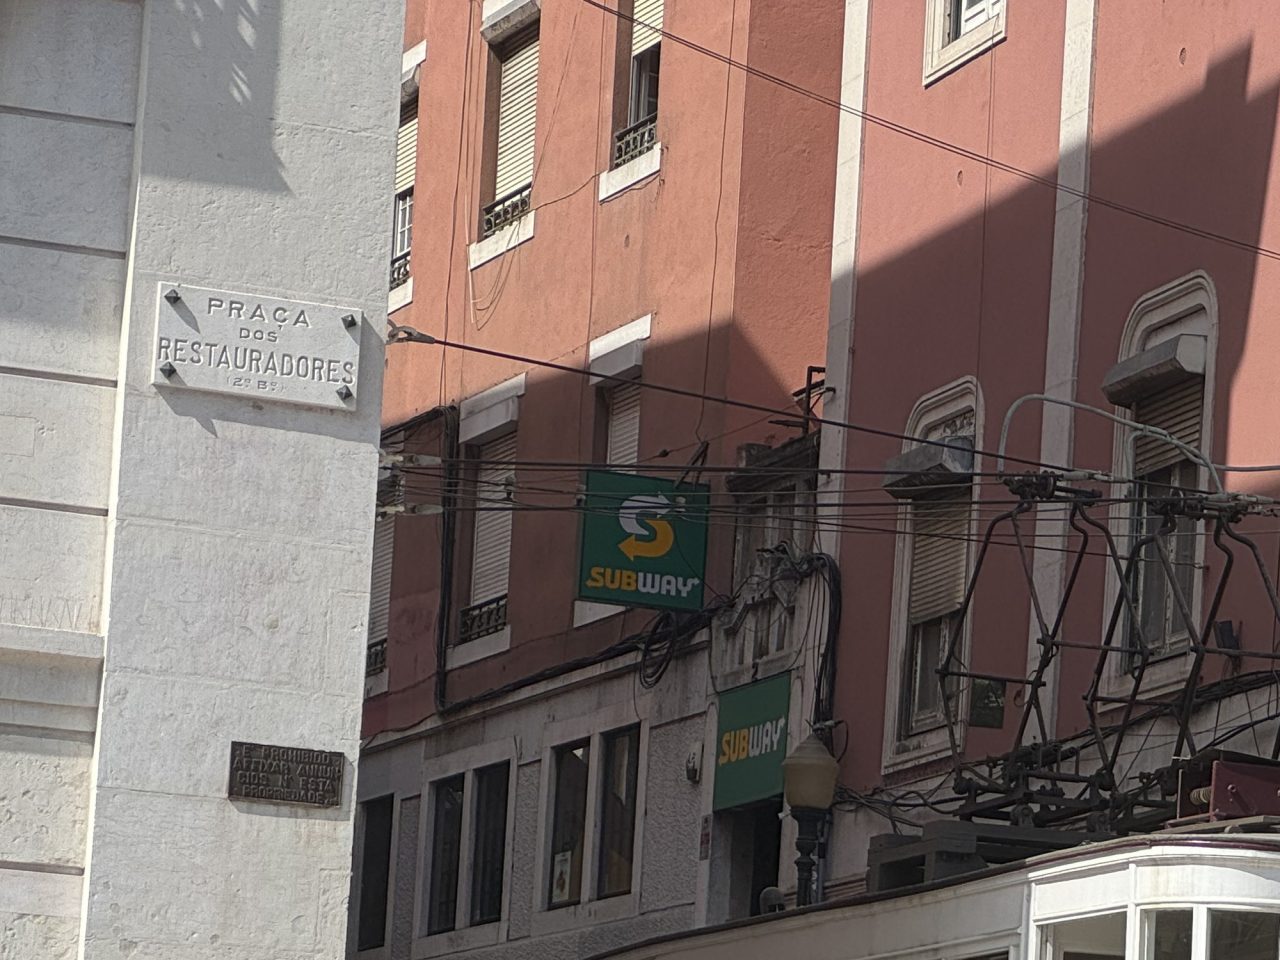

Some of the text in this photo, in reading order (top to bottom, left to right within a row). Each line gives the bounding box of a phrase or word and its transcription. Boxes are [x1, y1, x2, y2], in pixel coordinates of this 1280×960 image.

[208, 298, 312, 330] PRAÇA
[239, 327, 278, 343] DOS
[158, 337, 356, 385] RESTAURADORES
[586, 566, 700, 597] SUBWAY
[718, 715, 786, 766] SUBWAY
